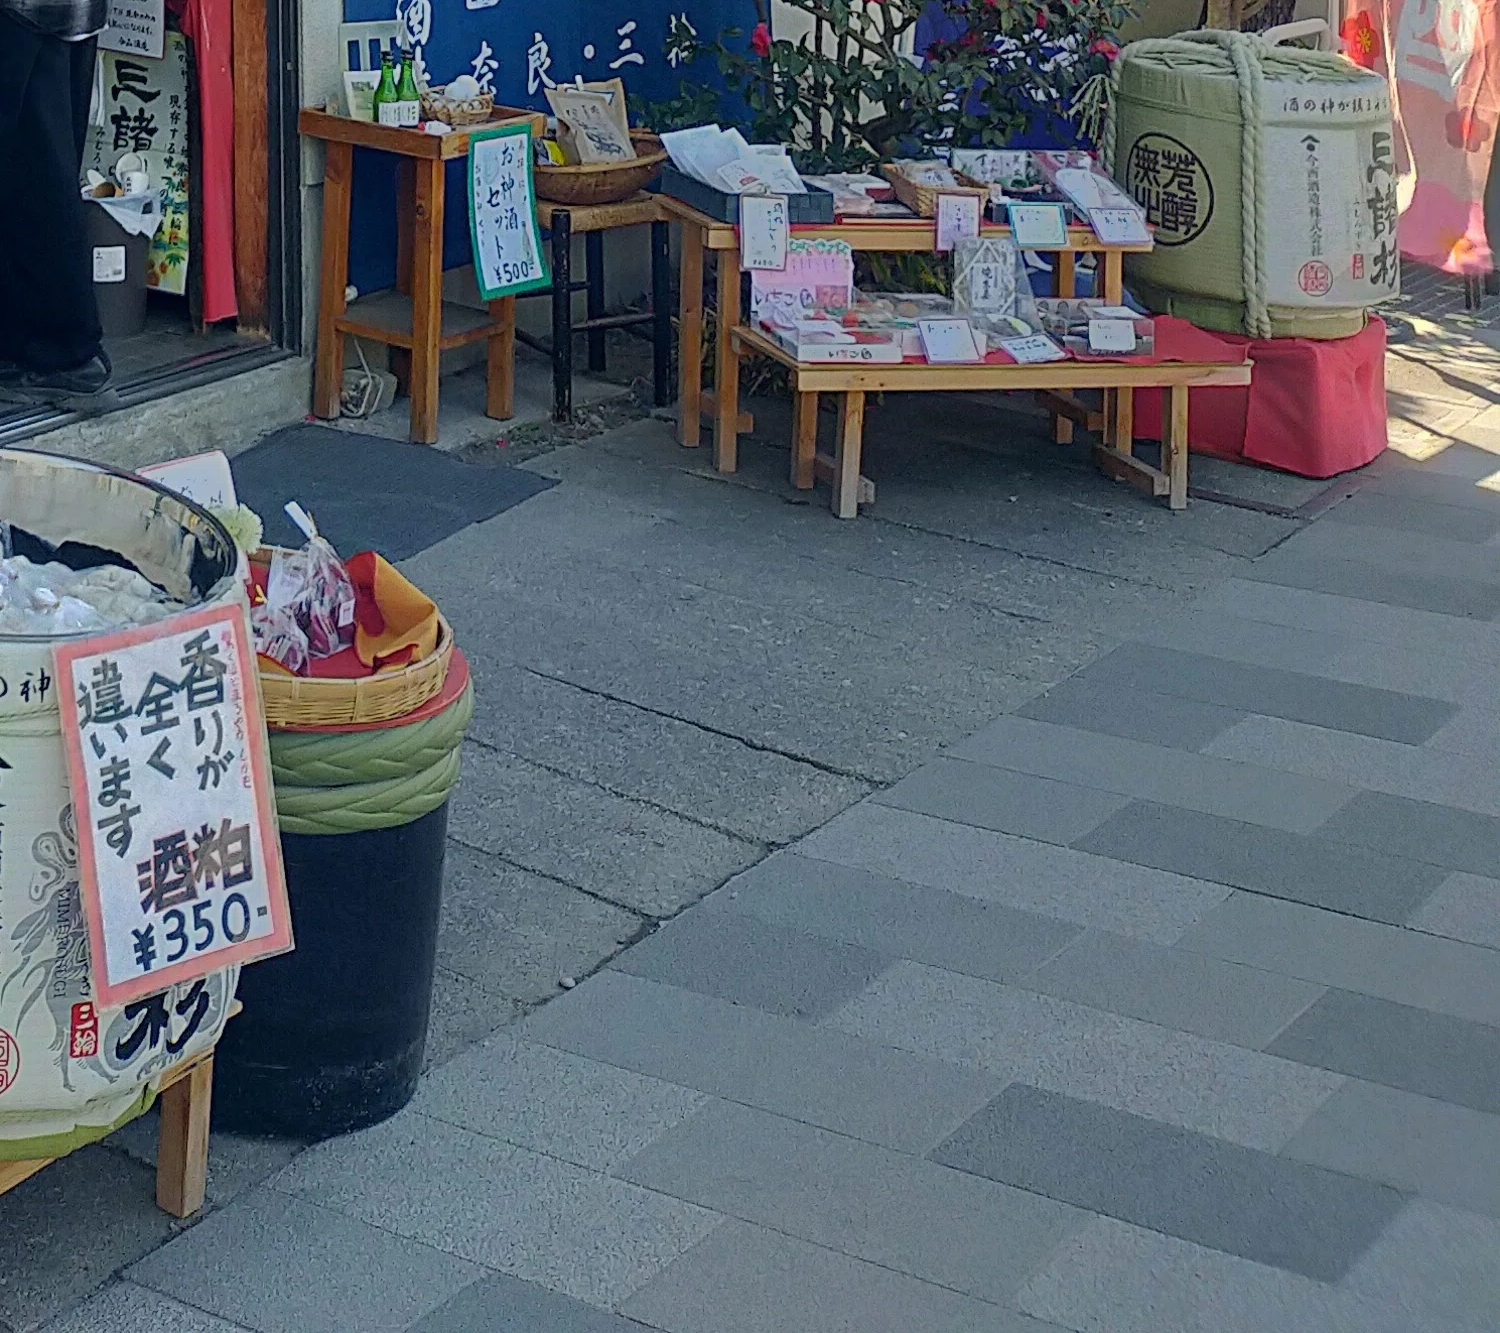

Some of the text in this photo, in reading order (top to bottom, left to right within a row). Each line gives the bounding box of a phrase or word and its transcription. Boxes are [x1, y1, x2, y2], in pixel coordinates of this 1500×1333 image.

[110, 57, 162, 185] 三諸
[1305, 153, 1323, 257] 今西酒造株式会社
[76, 660, 142, 857] 違います
[135, 670, 186, 781] 全く
[180, 629, 234, 791] 香りが
[136, 817, 253, 913] 酒粕
